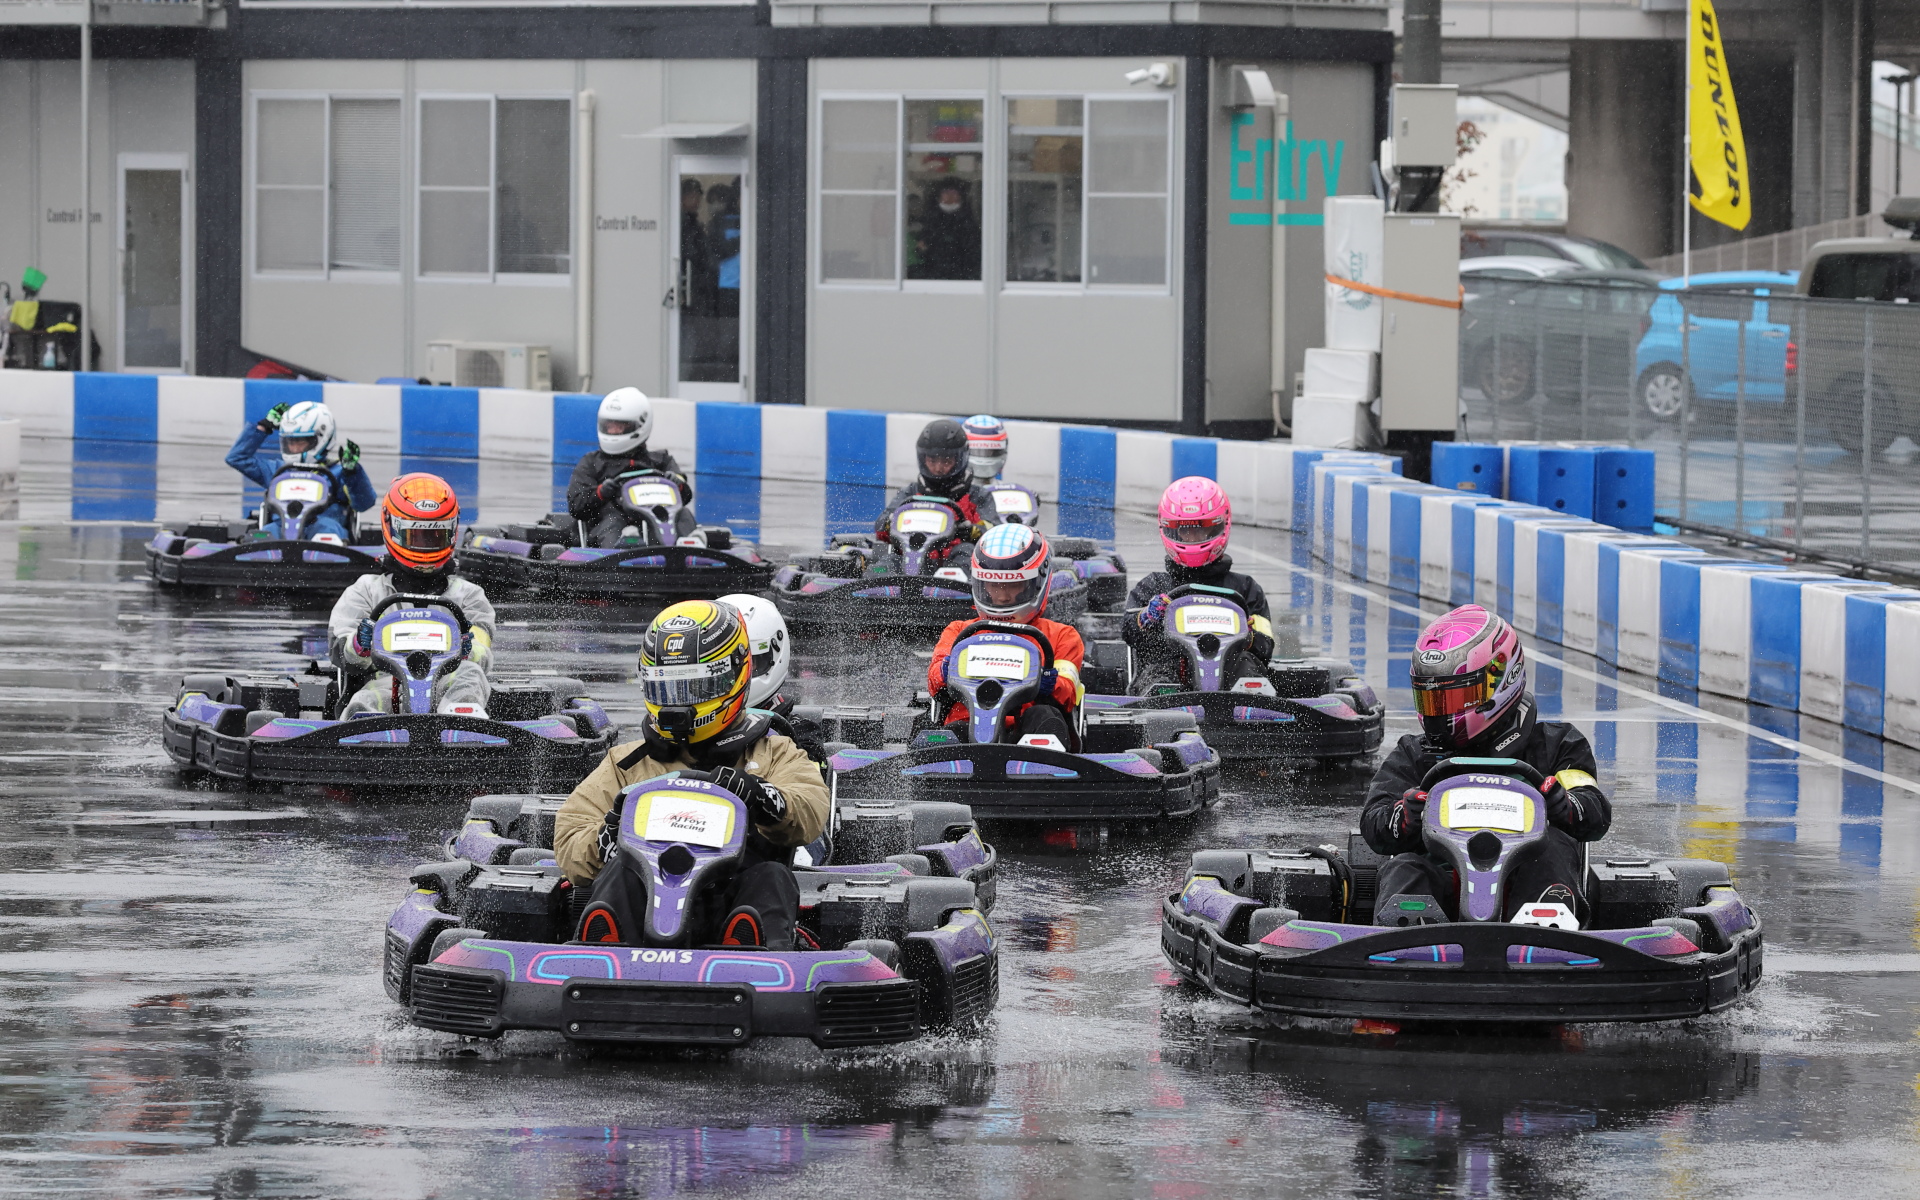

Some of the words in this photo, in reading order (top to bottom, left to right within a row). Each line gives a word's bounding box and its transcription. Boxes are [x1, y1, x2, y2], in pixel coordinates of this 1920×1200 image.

[1230, 113, 1345, 201] Entry
[596, 215, 629, 231] Control
[630, 215, 657, 231] Room
[419, 501, 438, 509] Arai
[976, 571, 1026, 580] HONDA
[667, 618, 695, 627] Arai
[667, 637, 686, 652] cpd
[1423, 650, 1442, 661] Arai
[666, 778, 712, 790] TOM'S
[1468, 775, 1511, 786] TOM'S
[670, 821, 706, 833] Racing
[631, 949, 694, 964] TOM'S
